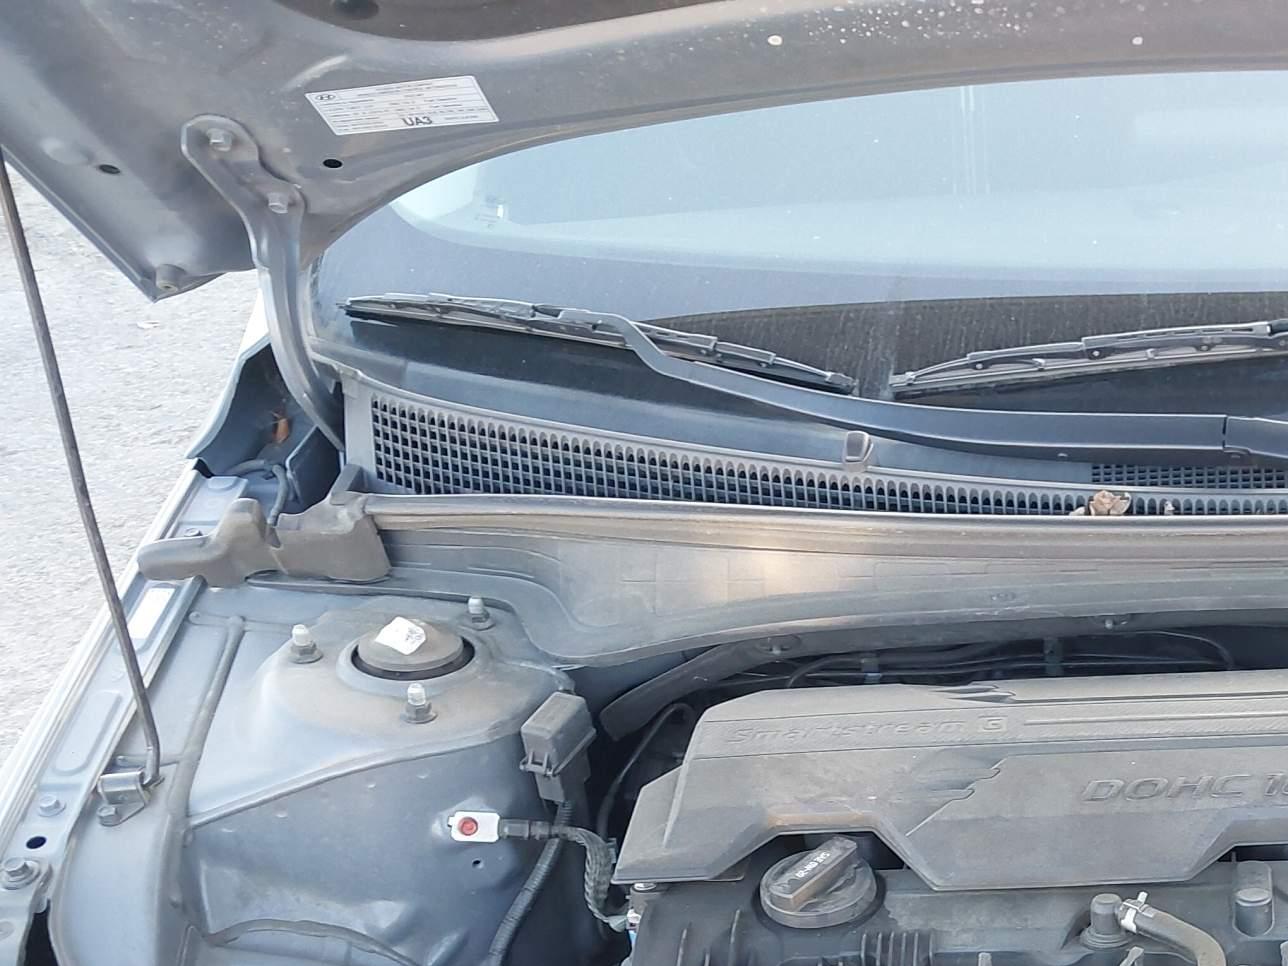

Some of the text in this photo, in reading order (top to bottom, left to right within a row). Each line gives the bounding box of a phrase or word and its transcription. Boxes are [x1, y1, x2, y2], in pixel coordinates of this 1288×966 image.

[401, 116, 433, 127] UA3
[727, 719, 967, 744] Smartstream
[1081, 774, 1253, 802] DOHC
